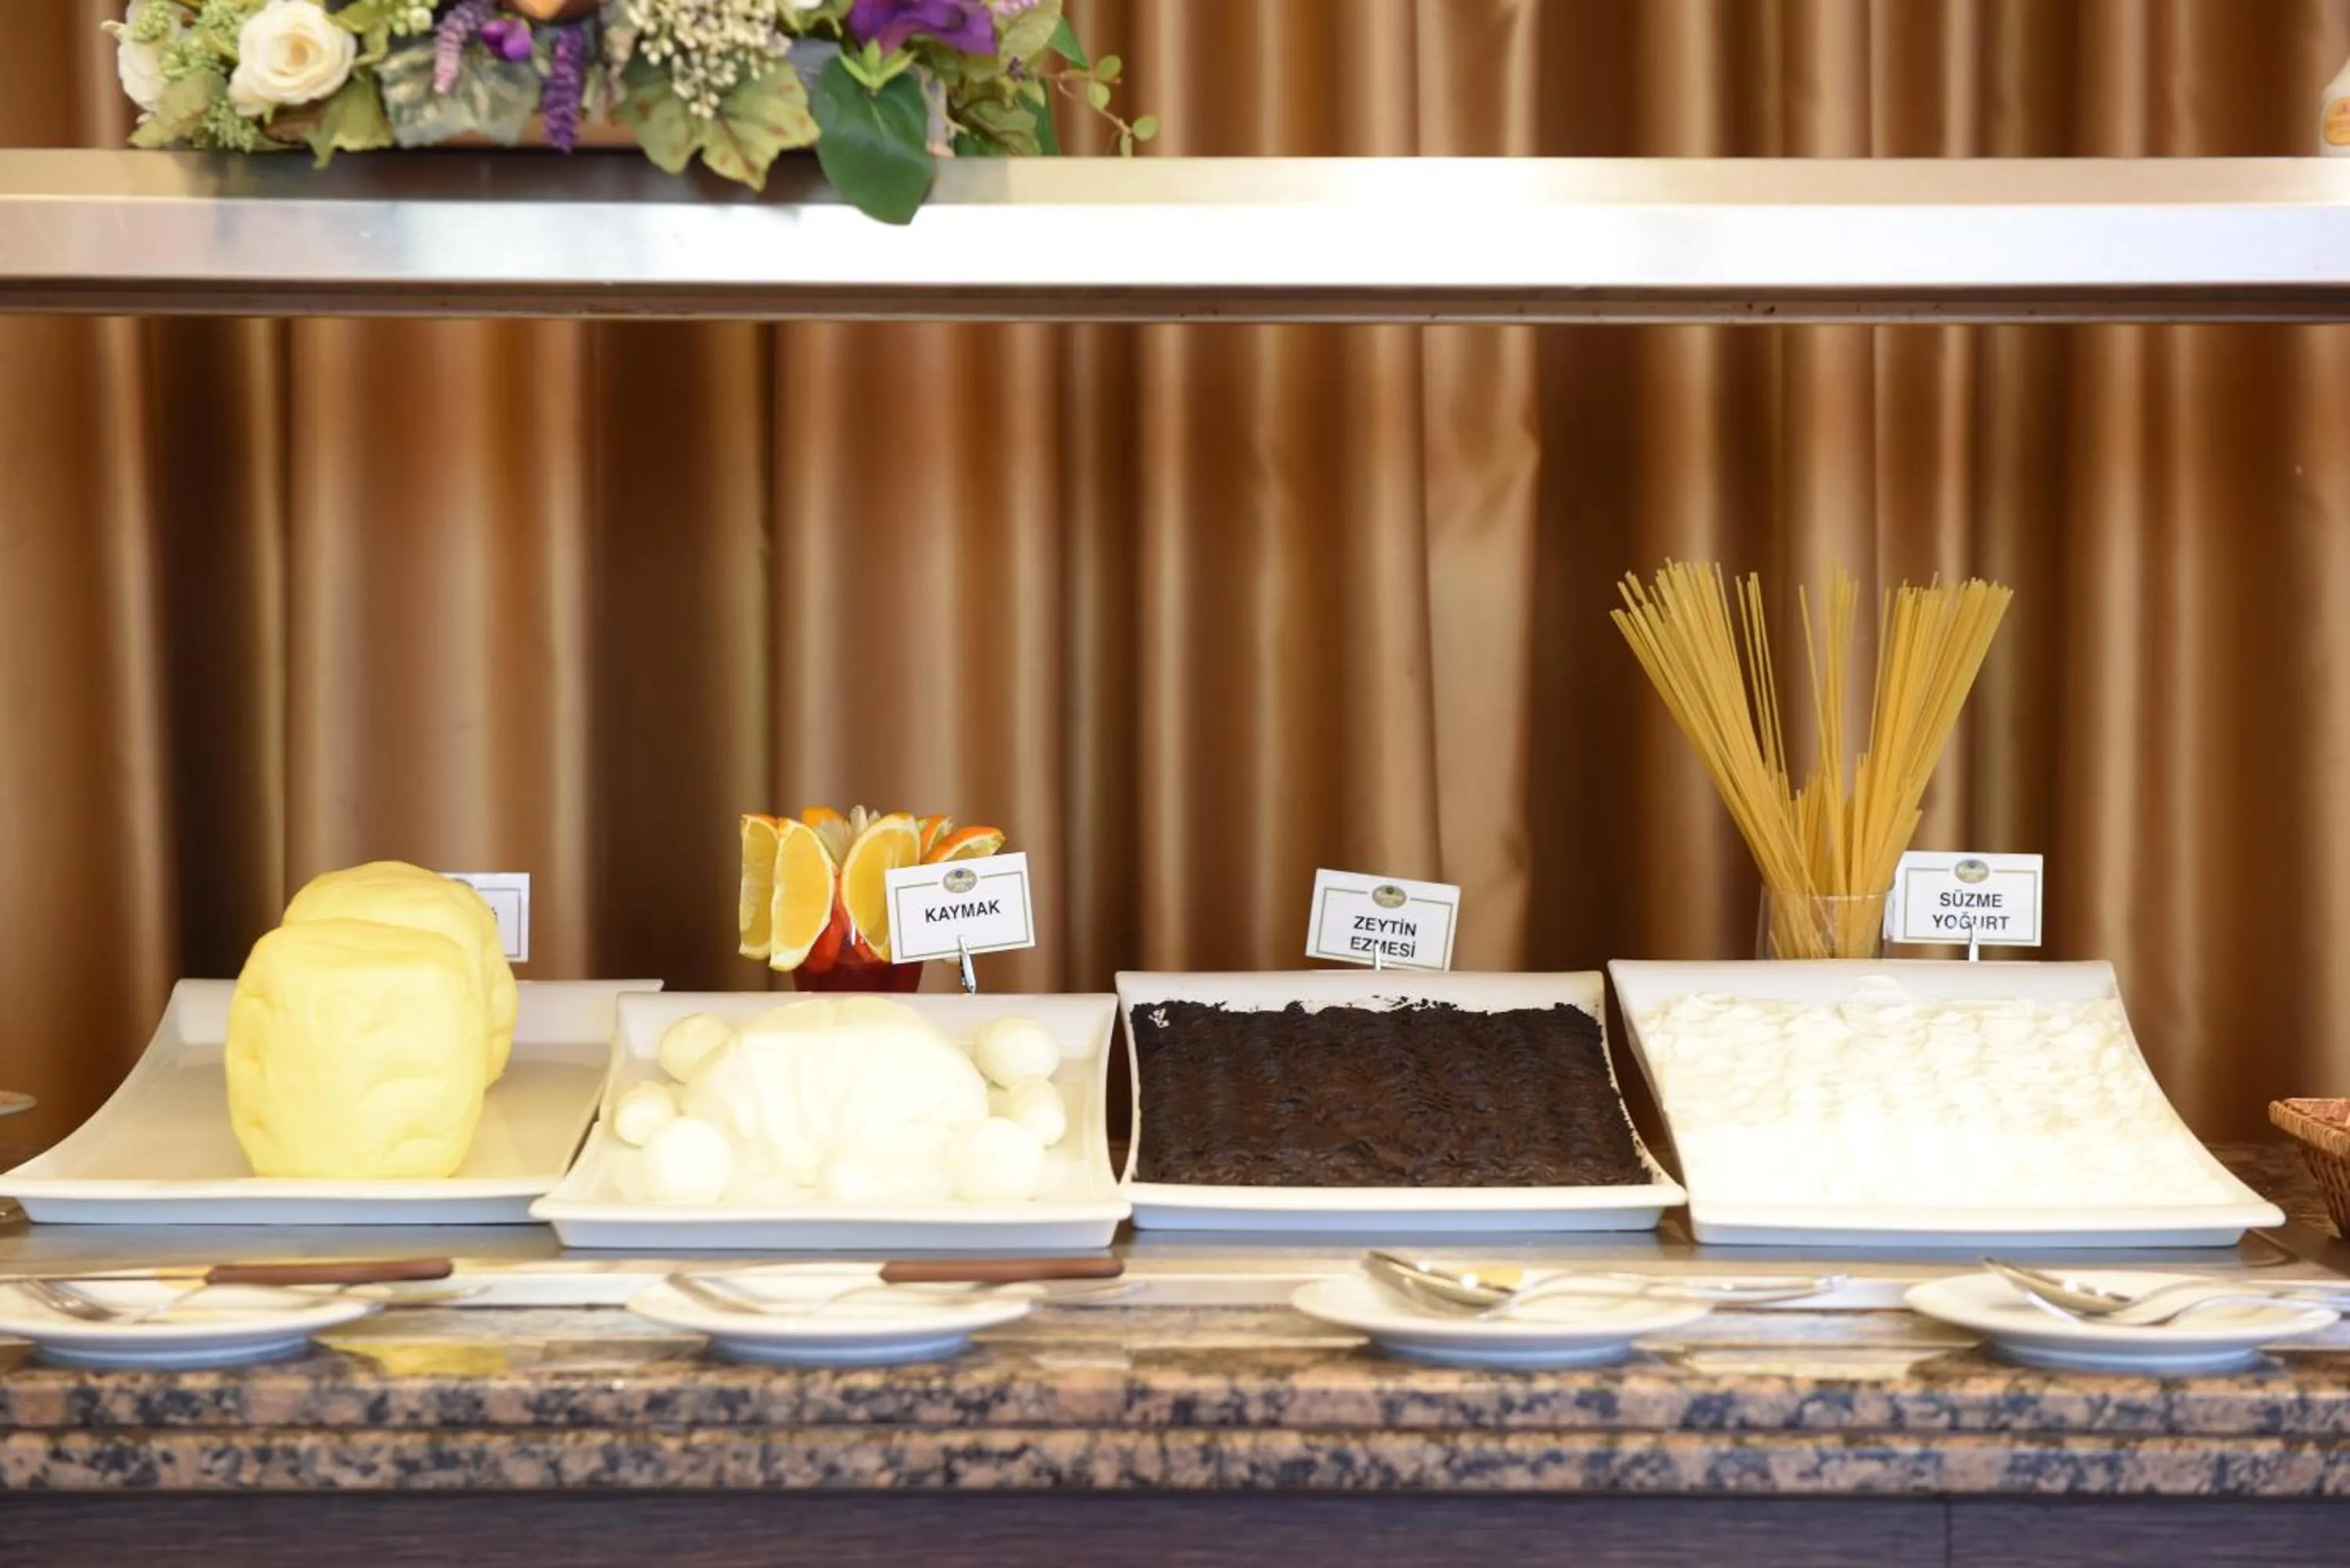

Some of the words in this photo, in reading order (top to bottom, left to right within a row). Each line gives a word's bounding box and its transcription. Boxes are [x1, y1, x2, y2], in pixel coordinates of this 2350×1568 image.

[1940, 890, 2003, 909] SÜZME
[925, 899, 1001, 923] KAYMAK
[1932, 911, 2010, 930] YOĞURT
[1353, 916, 1417, 937] ZEYTİN
[1350, 936, 1416, 958] EZMESİ
